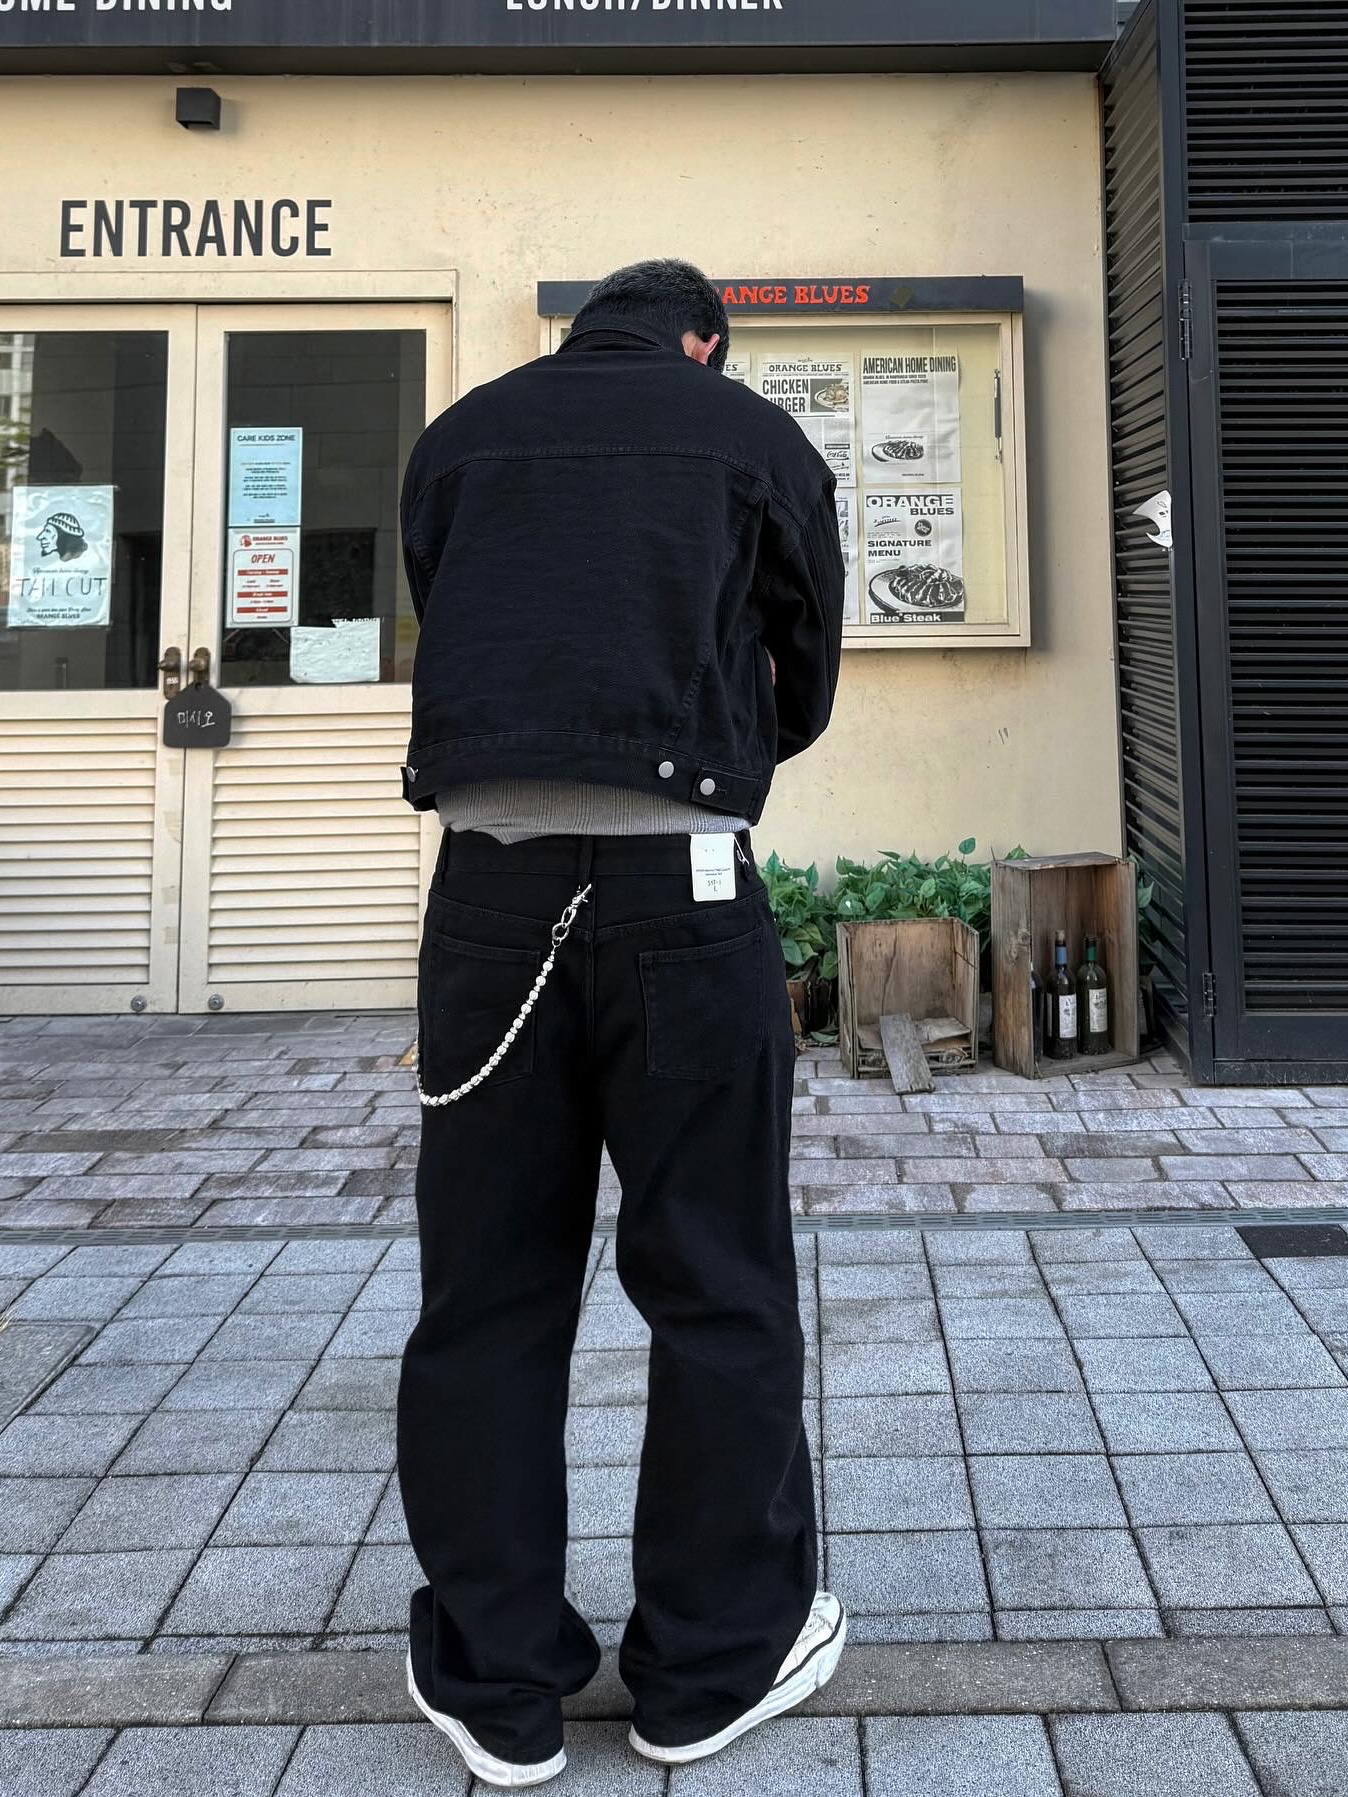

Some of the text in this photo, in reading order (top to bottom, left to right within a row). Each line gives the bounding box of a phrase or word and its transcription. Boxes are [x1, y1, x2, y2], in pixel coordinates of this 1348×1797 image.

[60, 199, 332, 257] ENTRANCE
[721, 285, 871, 304] ANGE BLUES
[768, 364, 843, 372] ORANGE BLUES
[863, 356, 956, 374] AMERICAN HOME DINING
[762, 379, 809, 395] CHICKEN
[866, 495, 954, 507] ORANGE
[910, 507, 954, 516] BLUES
[867, 540, 932, 548] SIGNATURE
[251, 553, 275, 564] OPEN
[871, 613, 942, 623] Blue Steak
[177, 710, 215, 729] 미시오
